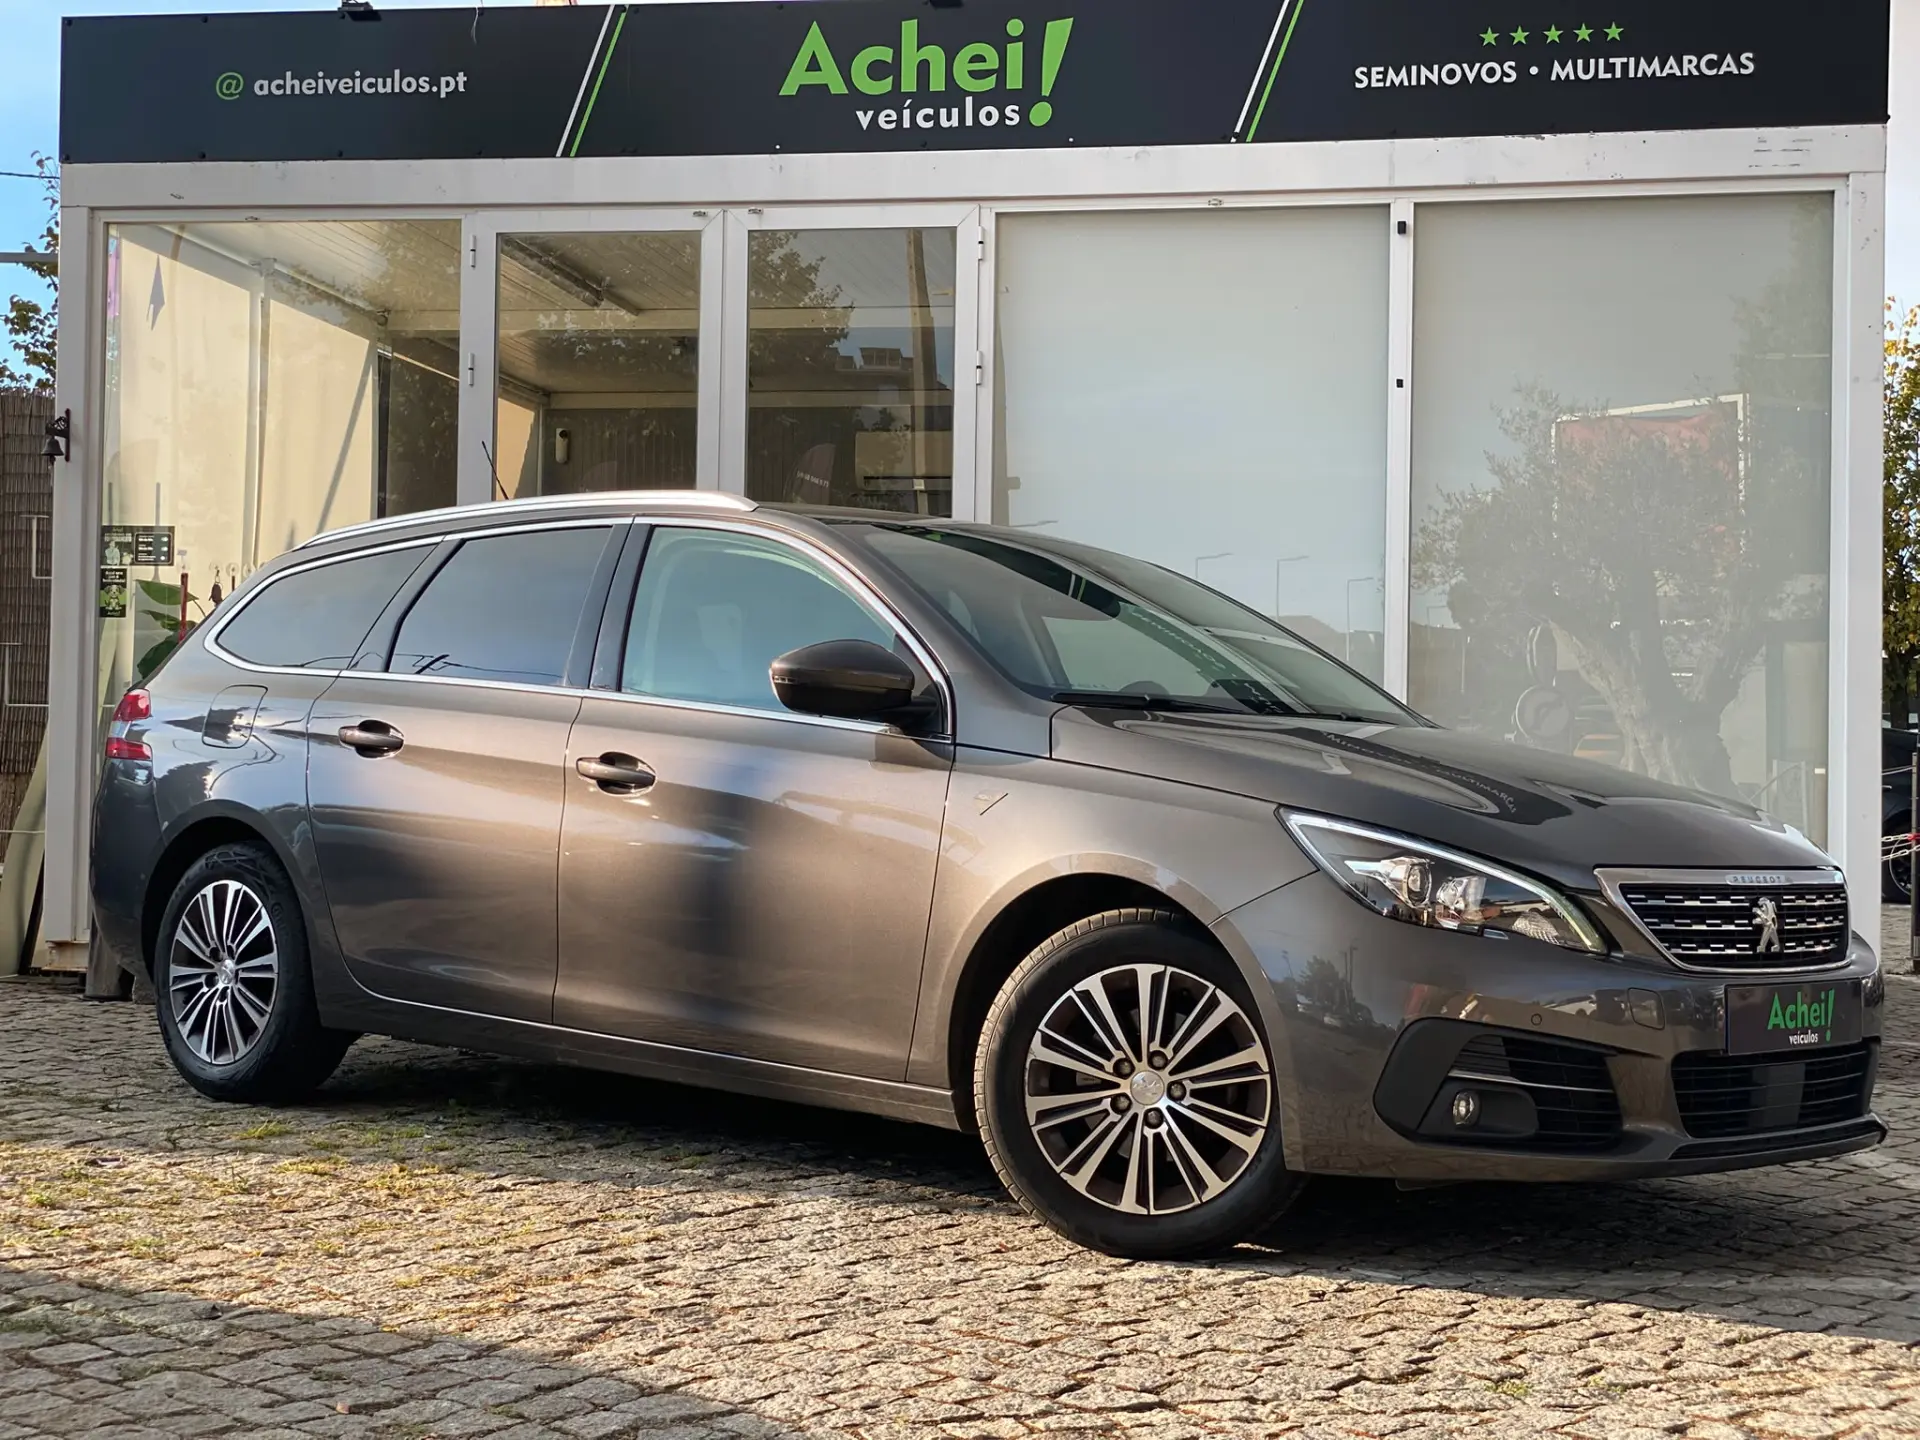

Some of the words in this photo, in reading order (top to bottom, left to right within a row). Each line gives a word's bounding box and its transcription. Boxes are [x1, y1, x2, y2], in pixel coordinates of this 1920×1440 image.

[215, 72, 244, 100] @
[253, 69, 468, 98] acheiveiculos.pt
[778, 17, 1074, 127] Achei!
[1354, 60, 1517, 89] SEMINOVOS
[1550, 52, 1755, 82] MULTIMARCAS
[856, 96, 1020, 130] veículos
[1733, 875, 1781, 884] PEUGEOT
[1767, 988, 1835, 1042] Achei!
